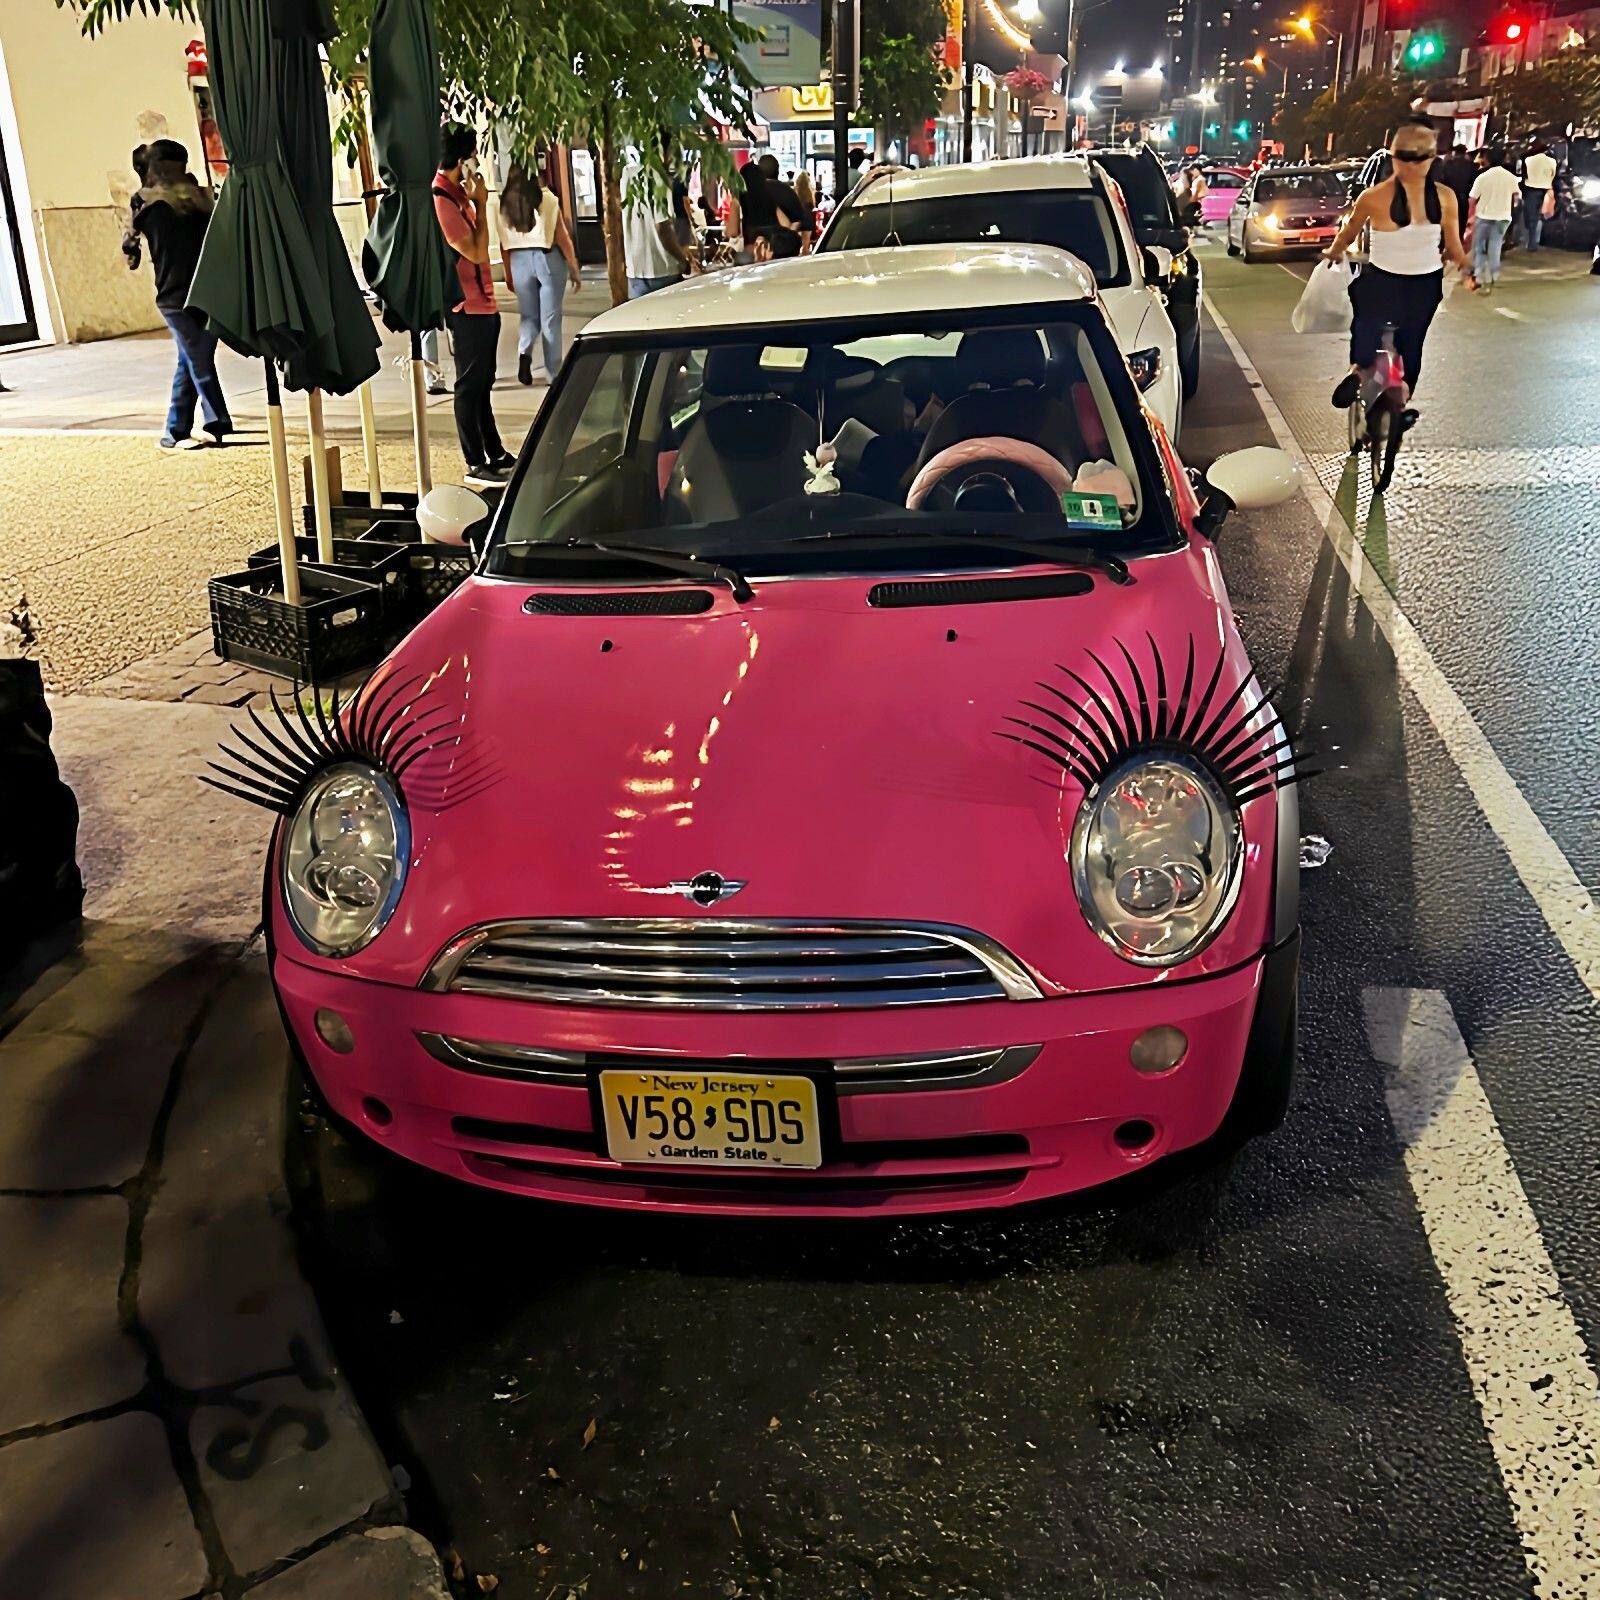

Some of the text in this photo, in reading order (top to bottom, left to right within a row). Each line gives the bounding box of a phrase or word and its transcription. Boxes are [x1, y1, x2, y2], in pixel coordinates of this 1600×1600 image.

[797, 86, 831, 106] CV
[652, 1075, 760, 1096] New Jersey
[617, 1095, 804, 1145] V58 SDS
[660, 1145, 768, 1161] Garden State
